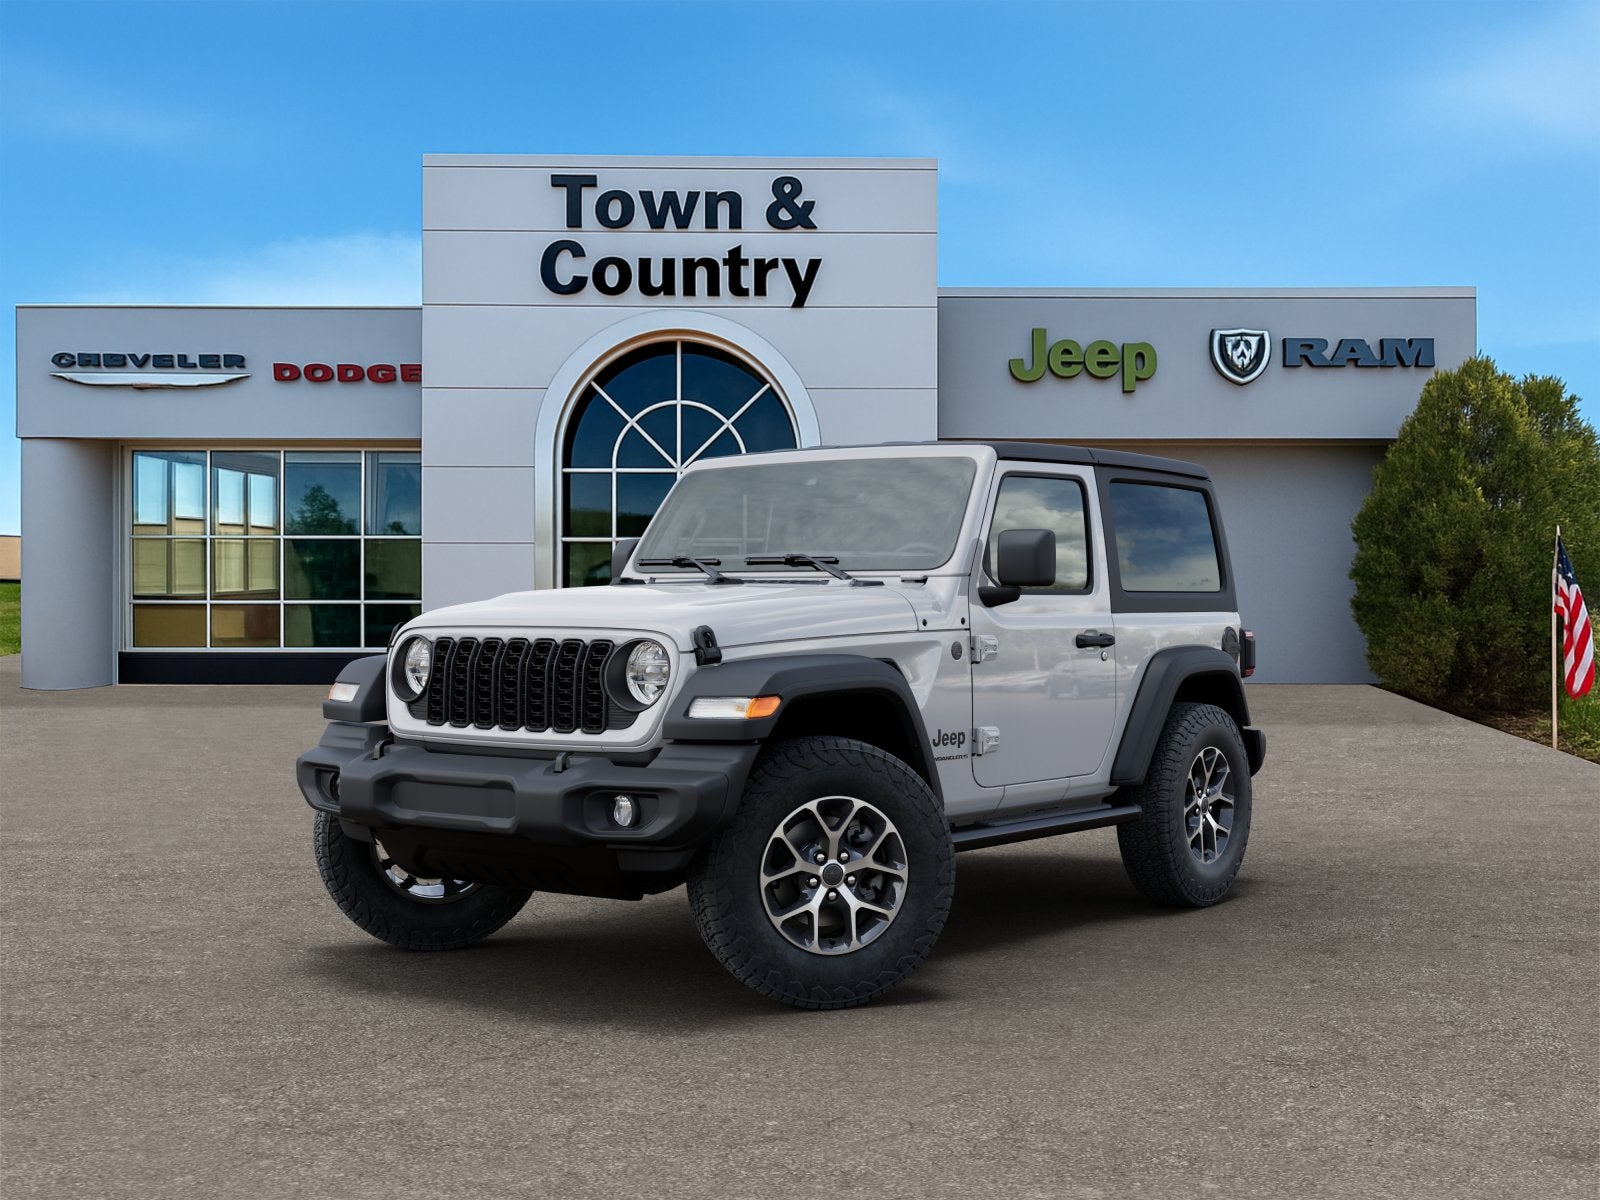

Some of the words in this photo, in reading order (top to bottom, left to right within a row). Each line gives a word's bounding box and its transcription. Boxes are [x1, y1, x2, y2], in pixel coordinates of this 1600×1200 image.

[550, 174, 742, 229] Town
[765, 176, 818, 230] &
[540, 239, 822, 308] Country
[273, 363, 422, 384] DODGE
[1008, 327, 1158, 393] Jeep
[1282, 337, 1435, 368] RAM
[933, 729, 965, 748] Jeep
